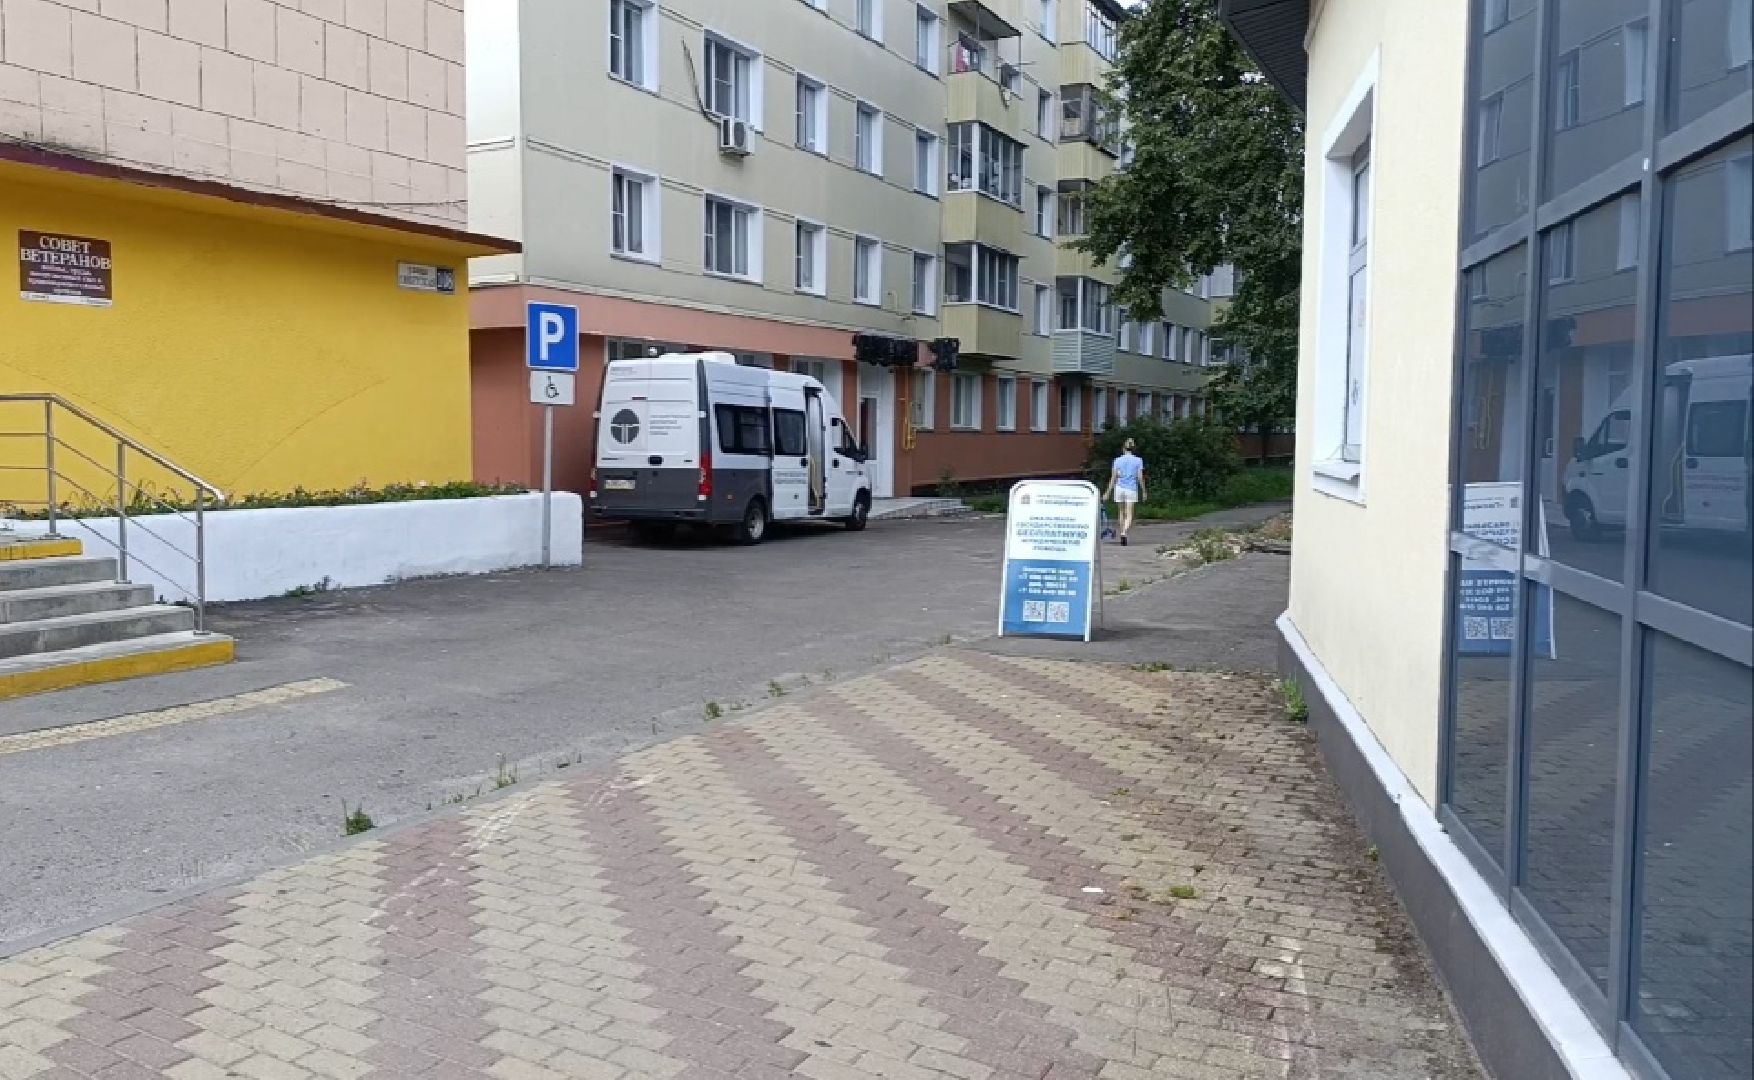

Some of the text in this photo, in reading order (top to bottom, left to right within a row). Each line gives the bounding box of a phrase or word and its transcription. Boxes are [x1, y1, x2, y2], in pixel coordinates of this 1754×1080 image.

[39, 235, 91, 254] СОВЕТ
[20, 248, 112, 269] ВЕТЕРАНОВ
[539, 312, 565, 361] P
